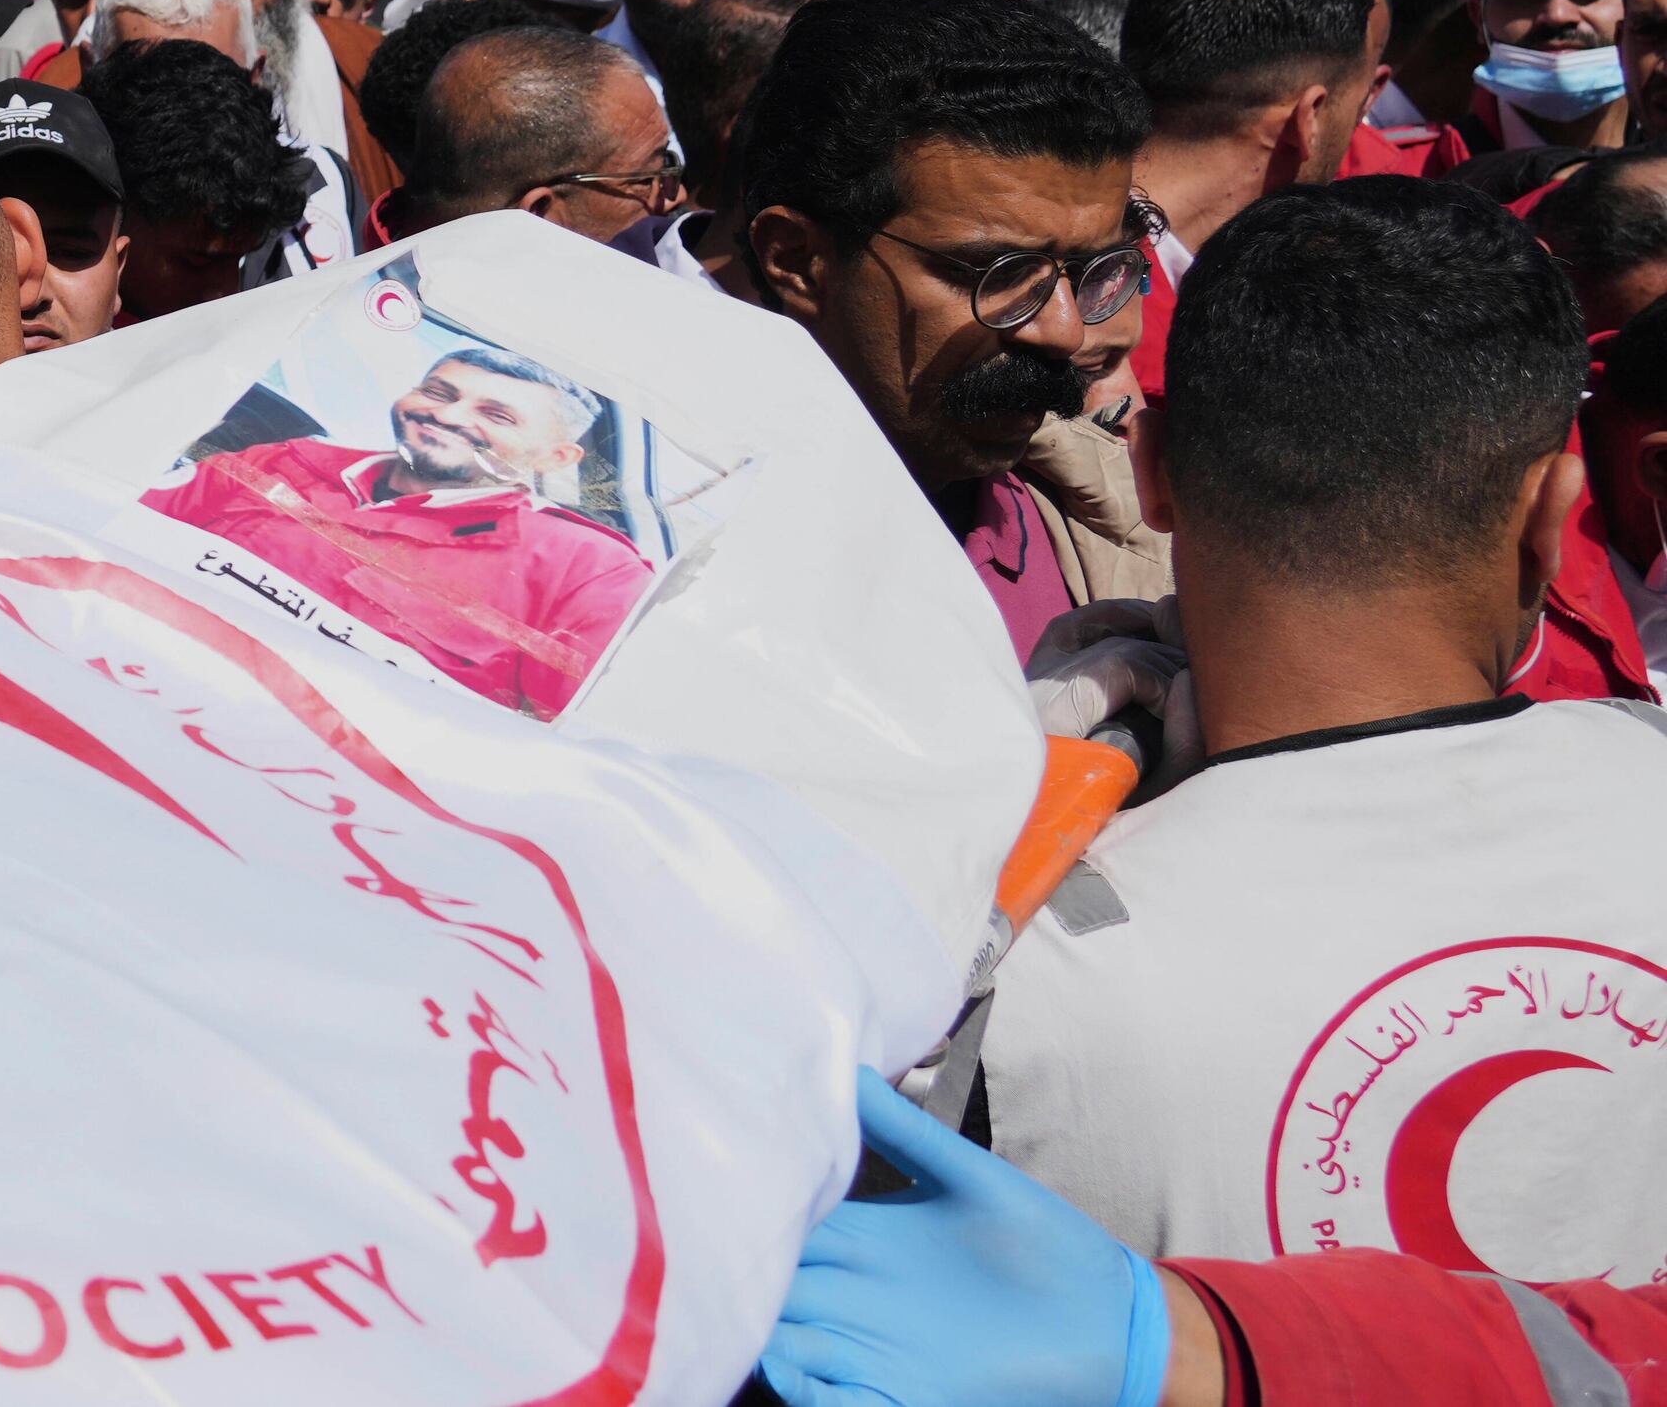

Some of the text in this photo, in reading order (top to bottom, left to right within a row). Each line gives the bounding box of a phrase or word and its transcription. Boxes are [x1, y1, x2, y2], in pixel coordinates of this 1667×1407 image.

[194, 549, 317, 622] المتطوع
[1442, 964, 1549, 1036] الأحمر
[1301, 1000, 1430, 1196] الفلسطيني
